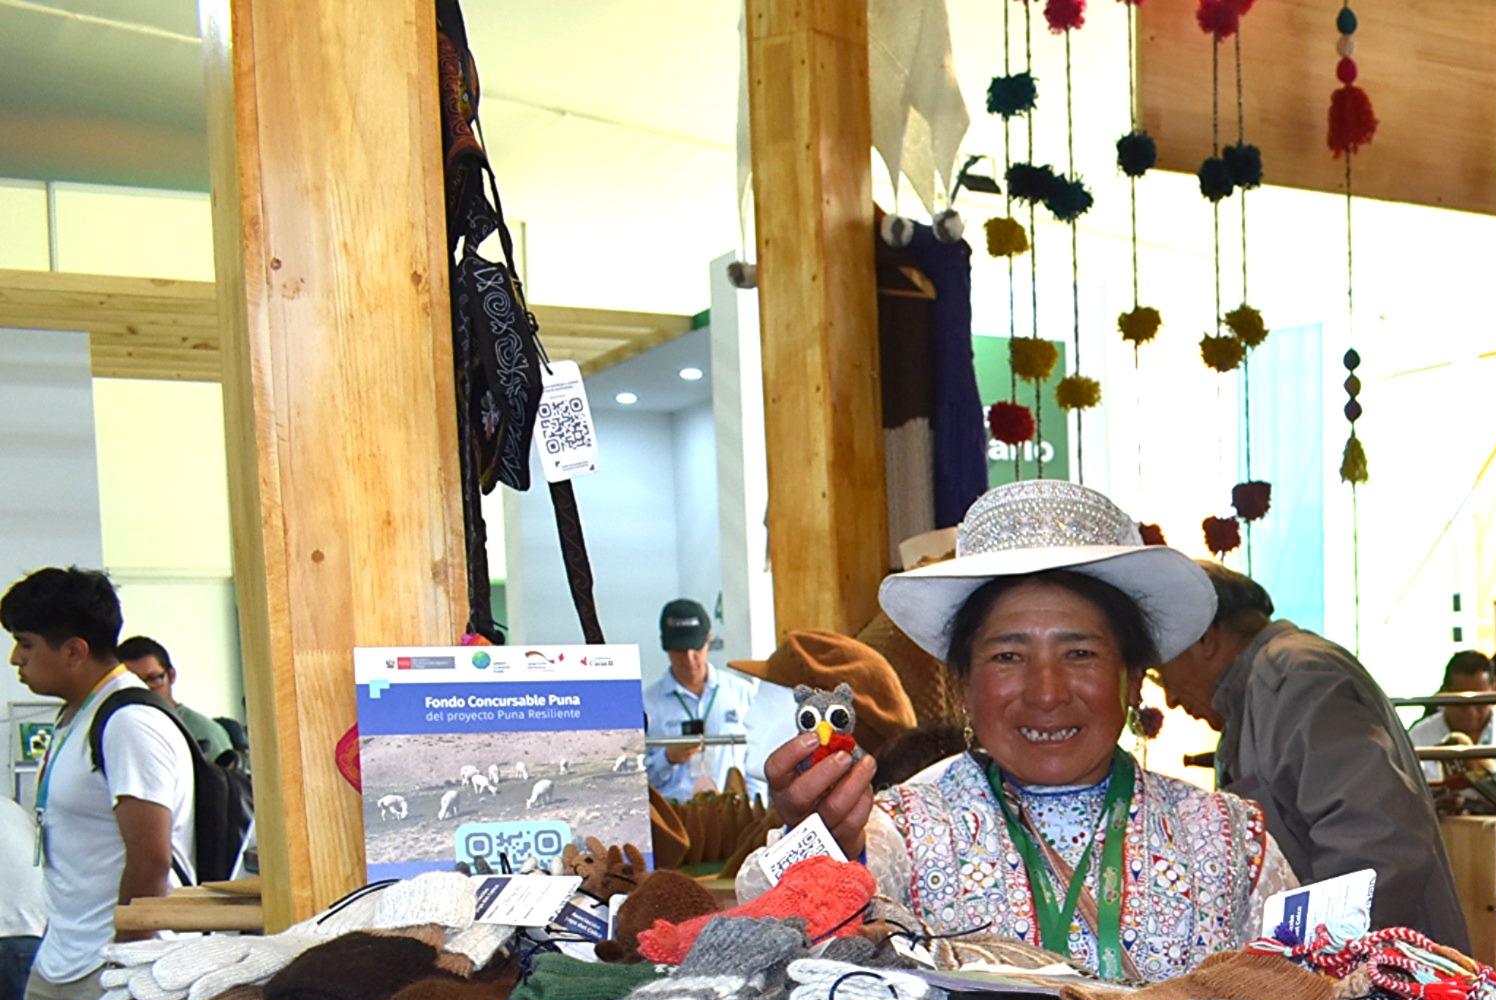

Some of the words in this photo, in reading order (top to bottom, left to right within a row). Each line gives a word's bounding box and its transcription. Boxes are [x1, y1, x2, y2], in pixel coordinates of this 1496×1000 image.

[425, 696, 466, 708] Fondo
[467, 694, 546, 707] Concursable
[548, 694, 581, 706] Puna
[425, 711, 444, 722] del
[447, 710, 495, 723] proyecto
[497, 710, 525, 720] Puna
[528, 708, 581, 719] Resiliente
